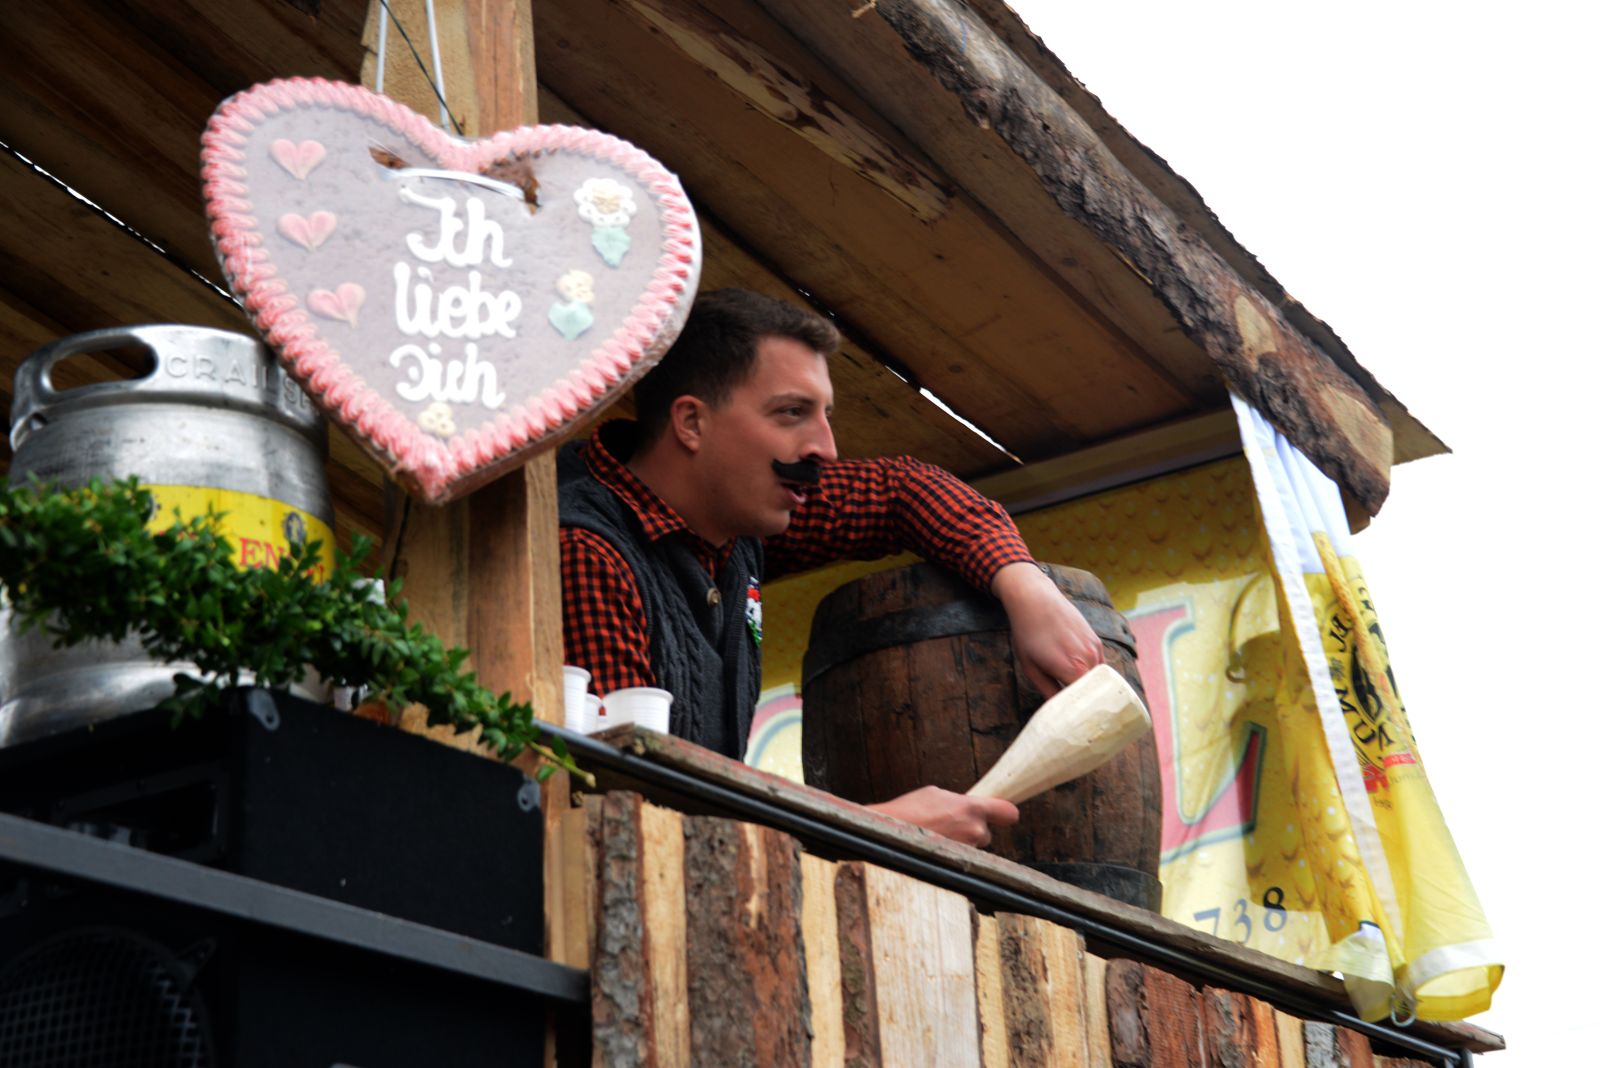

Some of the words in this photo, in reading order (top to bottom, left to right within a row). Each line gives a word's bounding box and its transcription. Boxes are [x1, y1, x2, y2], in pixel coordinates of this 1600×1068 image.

[399, 187, 513, 268] Ich
[393, 261, 523, 339] liebe
[389, 341, 507, 409] Dich
